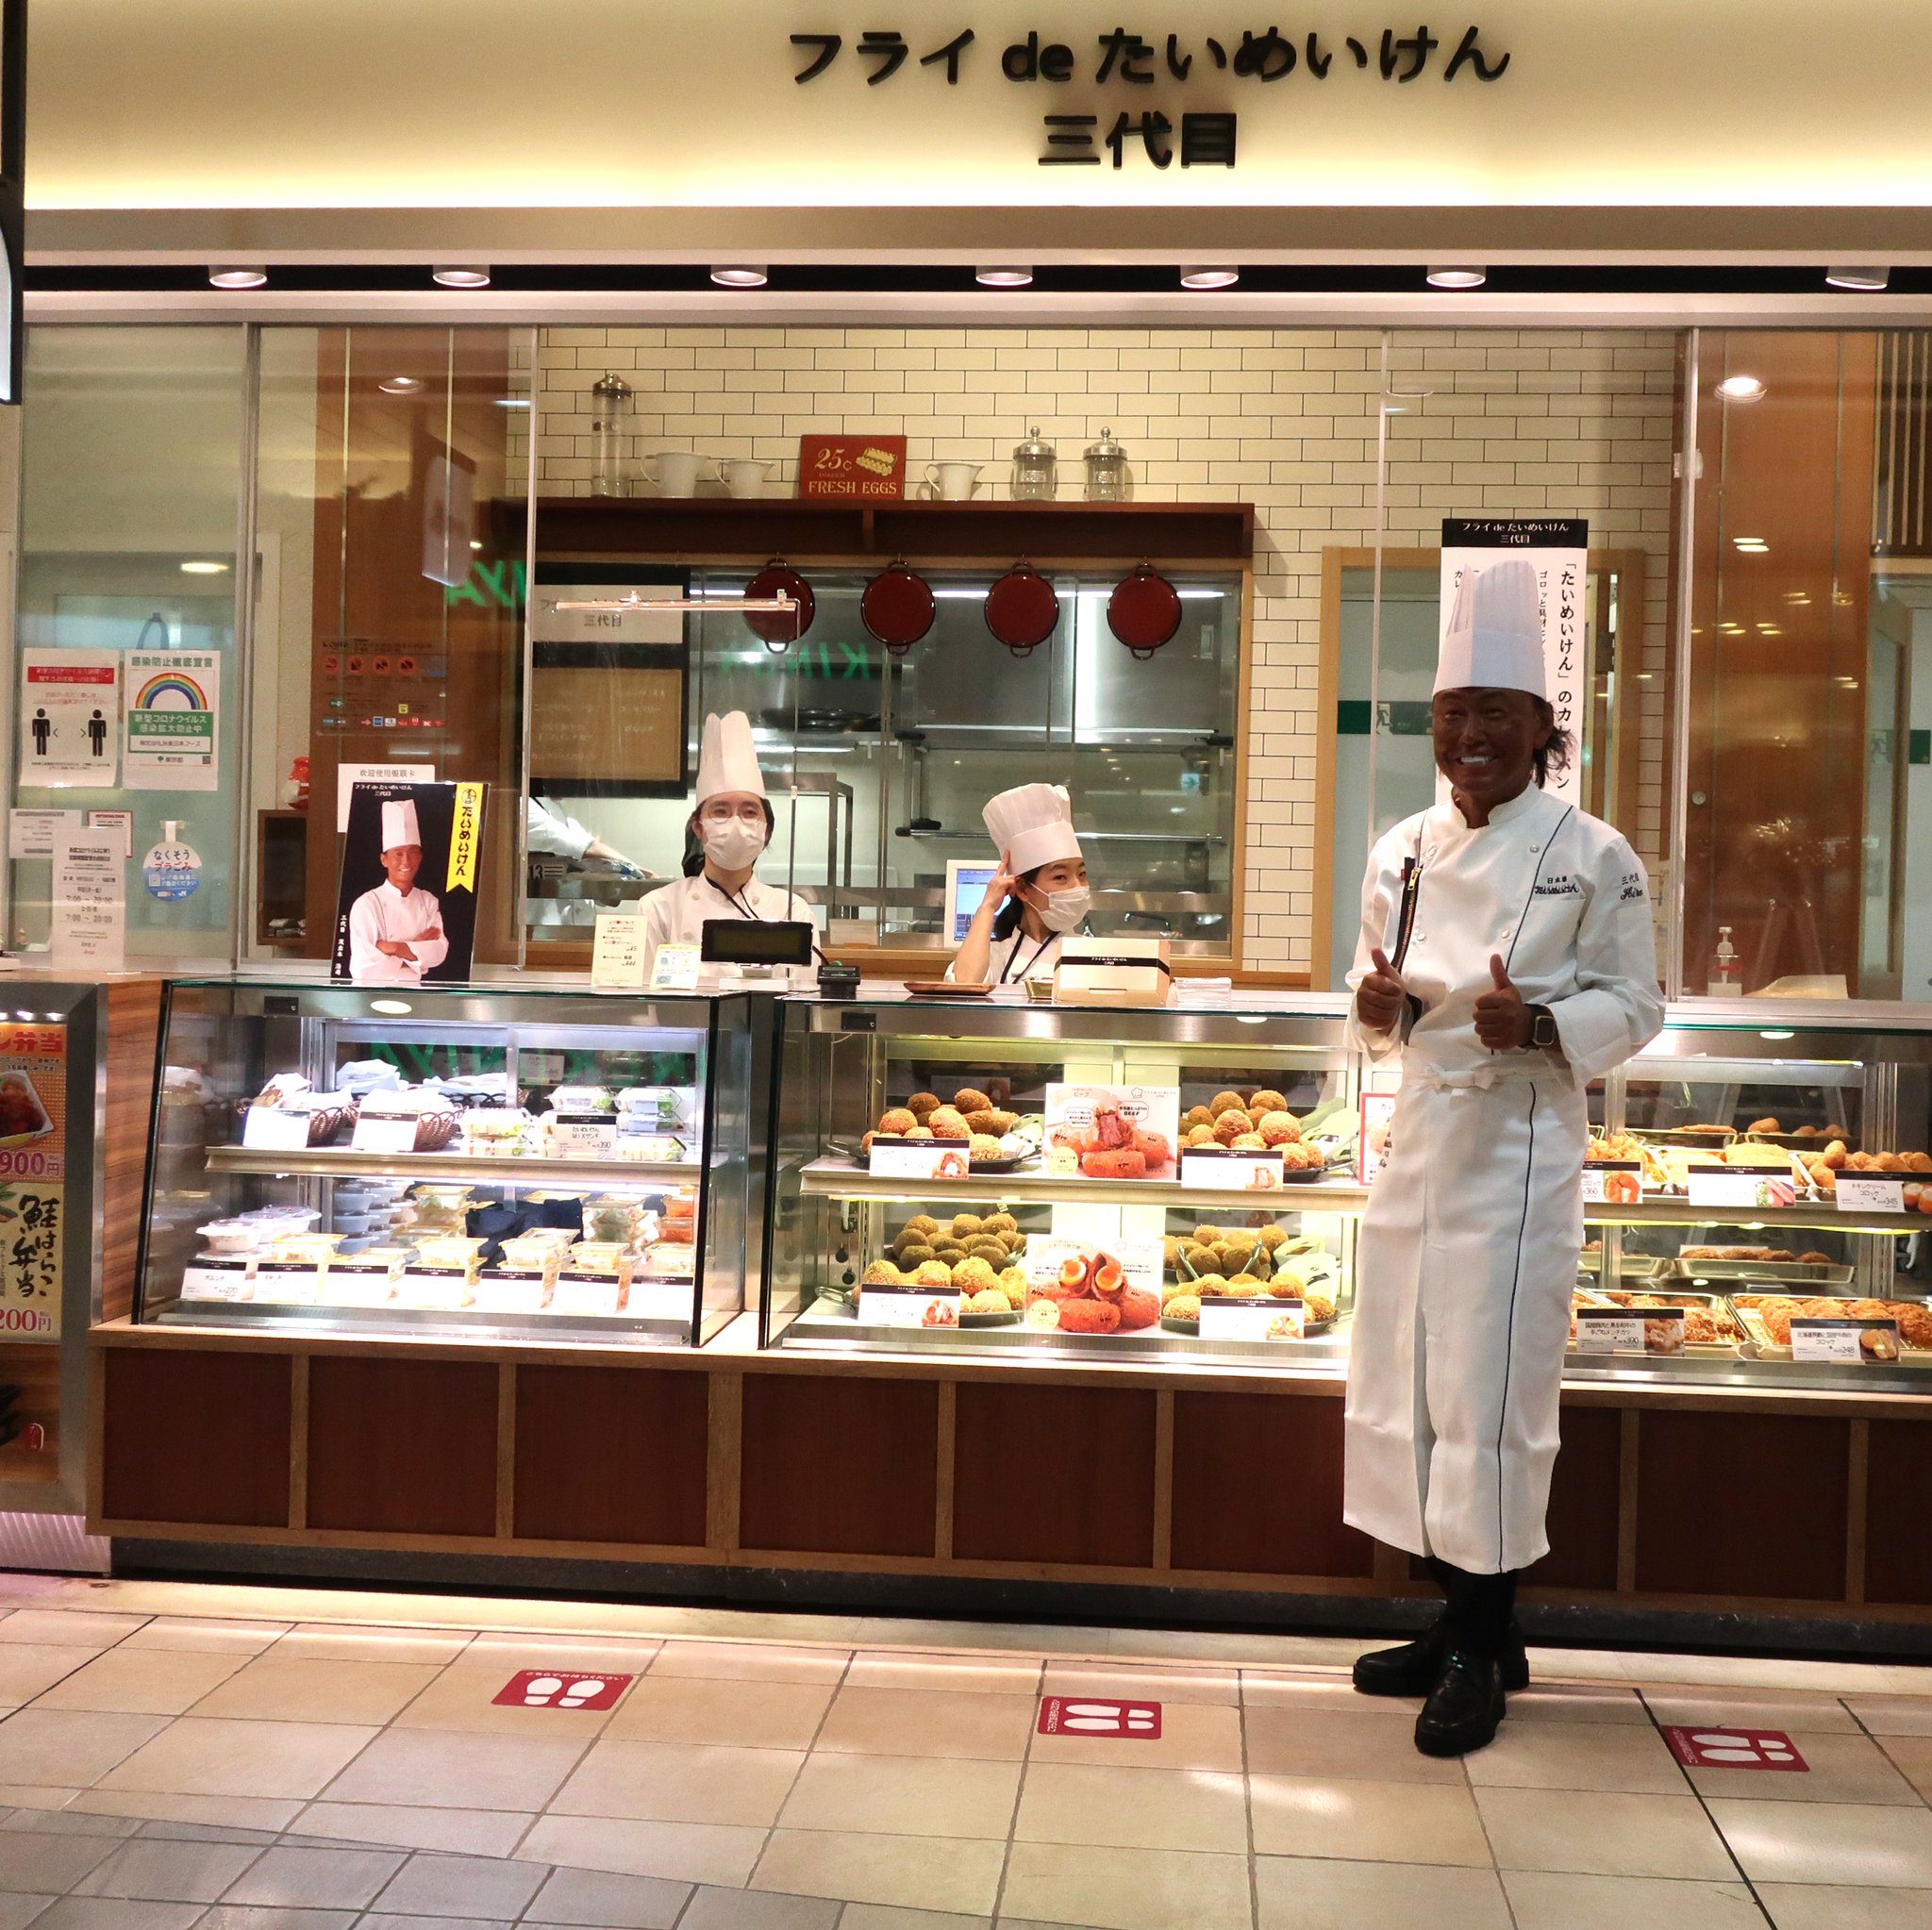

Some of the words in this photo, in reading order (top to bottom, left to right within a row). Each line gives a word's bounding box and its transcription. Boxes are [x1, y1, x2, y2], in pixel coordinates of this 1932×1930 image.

[790, 29, 975, 84] フライ
[1002, 30, 1074, 82] de
[1096, 26, 1510, 83] たいめいけん
[1038, 111, 1238, 171] 三代目
[808, 481, 856, 494] FRESH
[862, 482, 897, 494] EGGS
[1463, 523, 1491, 532] フライ
[1507, 523, 1570, 532] たいめいけん
[1500, 534, 1530, 544] 三代目
[584, 614, 623, 627] 三代目
[456, 806, 474, 876] たいめいけん
[154, 849, 190, 860] なくそう
[154, 861, 192, 872] プラごみ
[1622, 873, 1640, 885] 三代目
